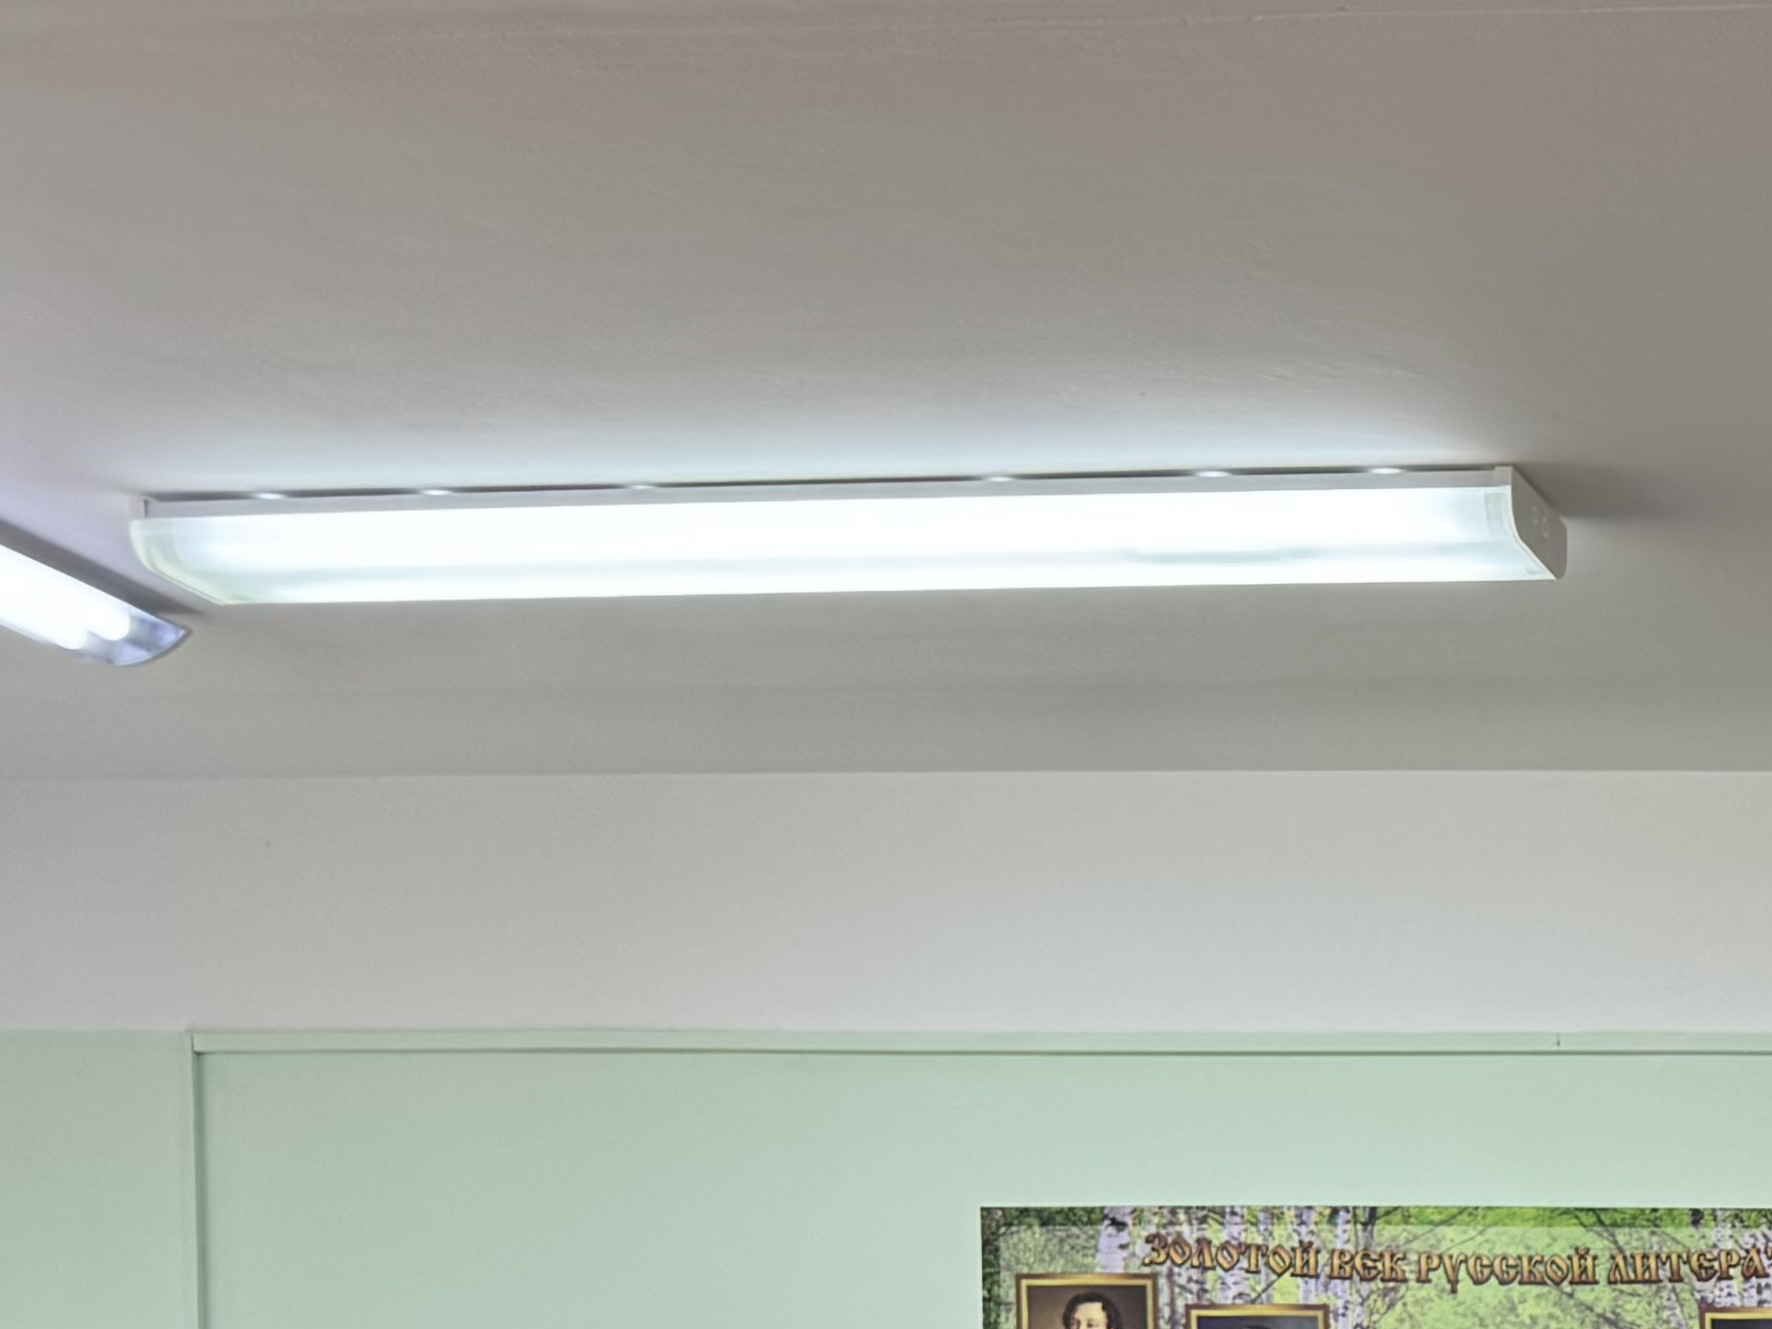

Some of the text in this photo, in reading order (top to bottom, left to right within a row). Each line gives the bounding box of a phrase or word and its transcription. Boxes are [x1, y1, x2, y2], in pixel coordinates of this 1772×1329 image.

[1142, 1232, 1320, 1278] ЗОЛОТОЙ
[1329, 1247, 1408, 1284] ВЕК
[1416, 1245, 1599, 1295] РУССКОЙ
